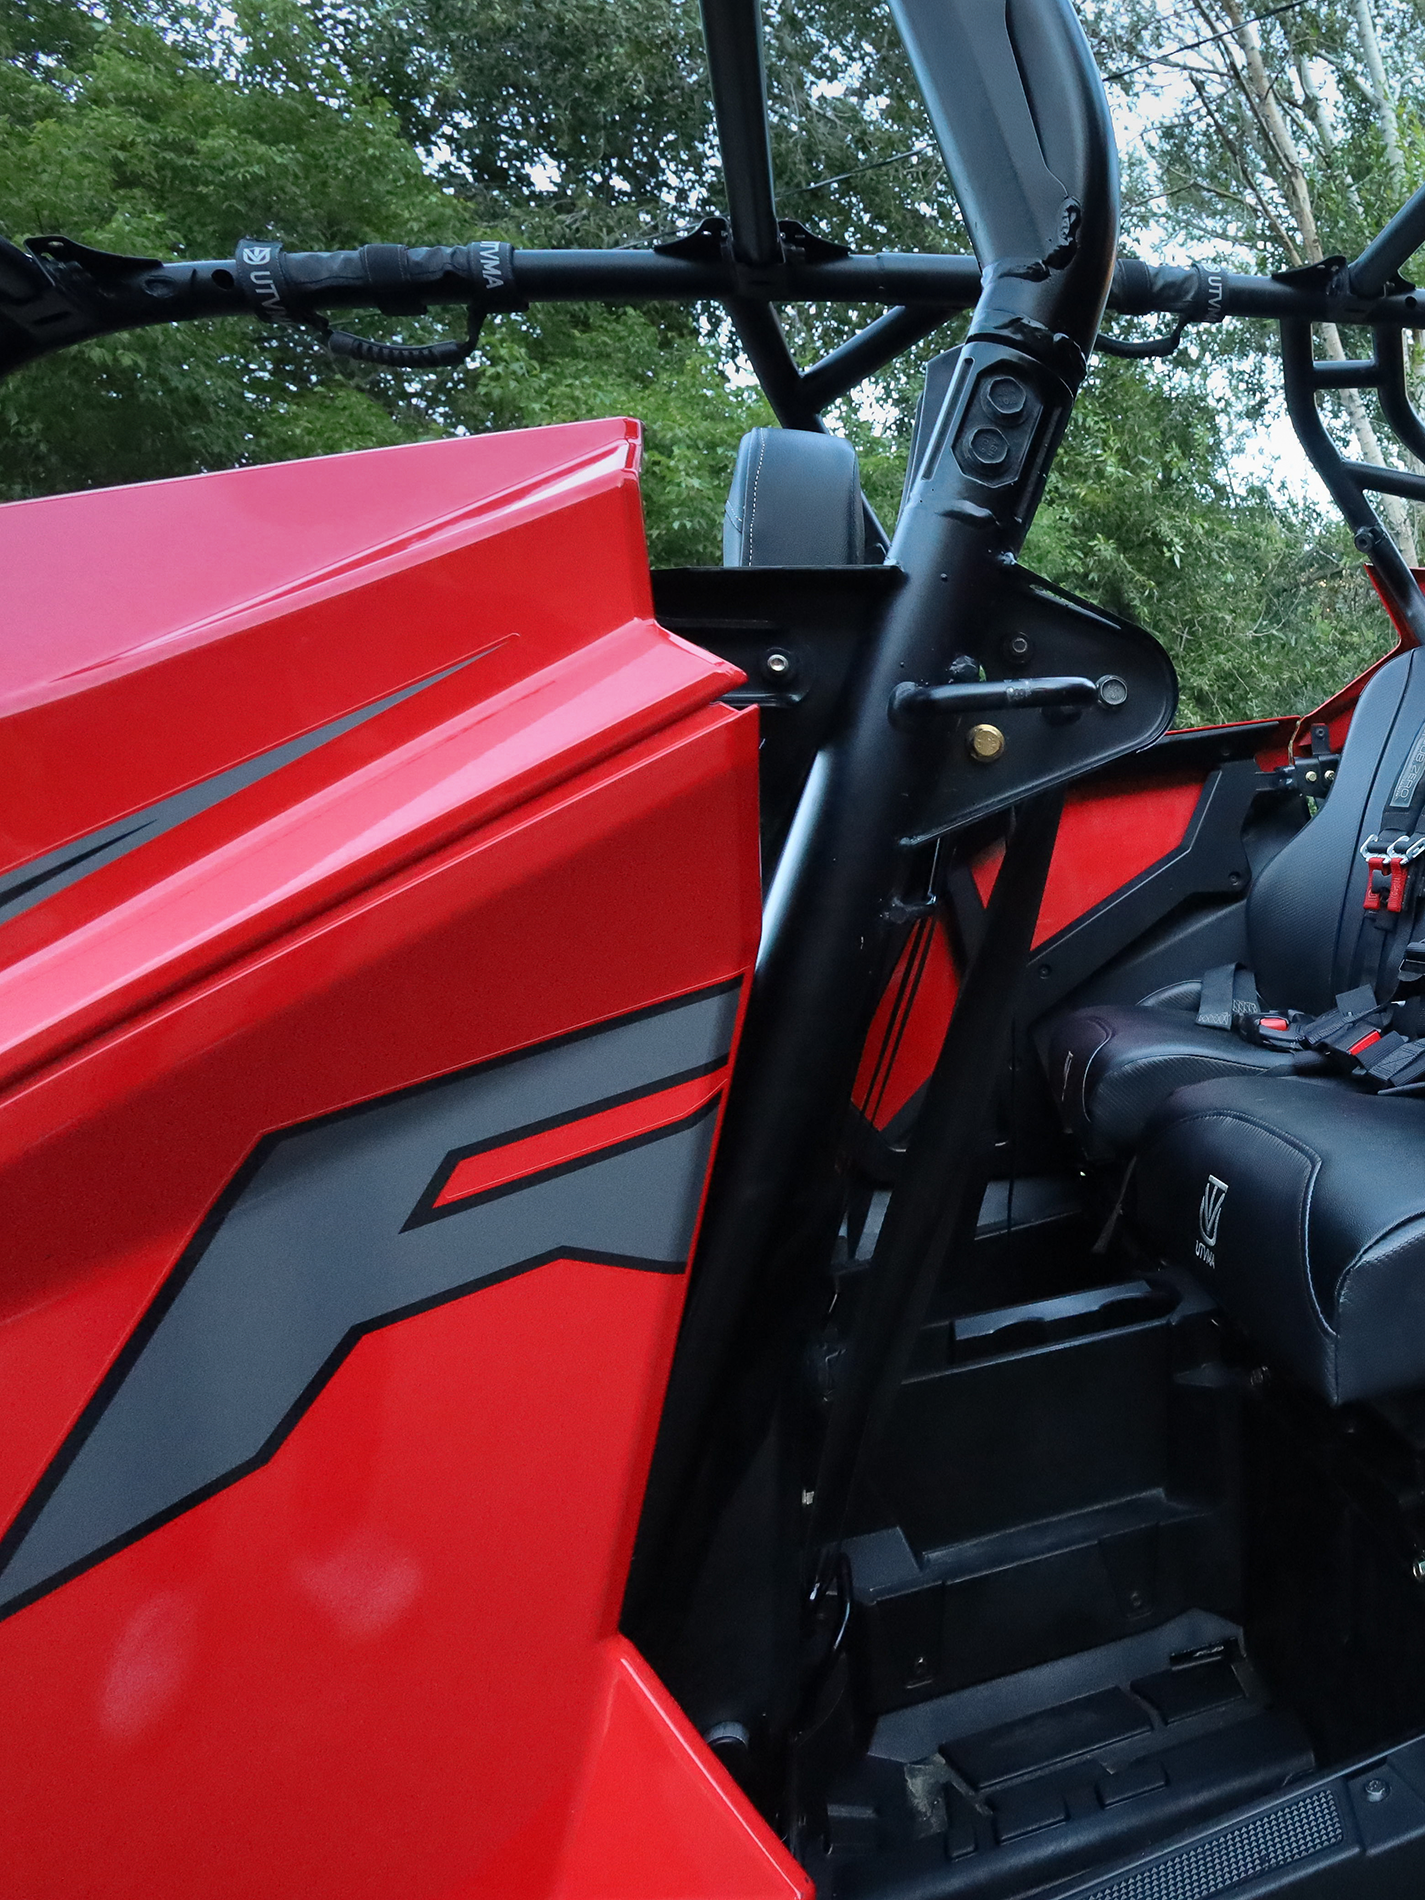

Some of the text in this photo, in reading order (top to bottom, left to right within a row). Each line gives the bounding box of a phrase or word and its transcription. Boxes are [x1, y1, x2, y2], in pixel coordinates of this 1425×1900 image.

[480, 241, 504, 289] TVMA
[1400, 764, 1421, 798] ZERO
[1195, 1239, 1216, 1270] UTVMA
